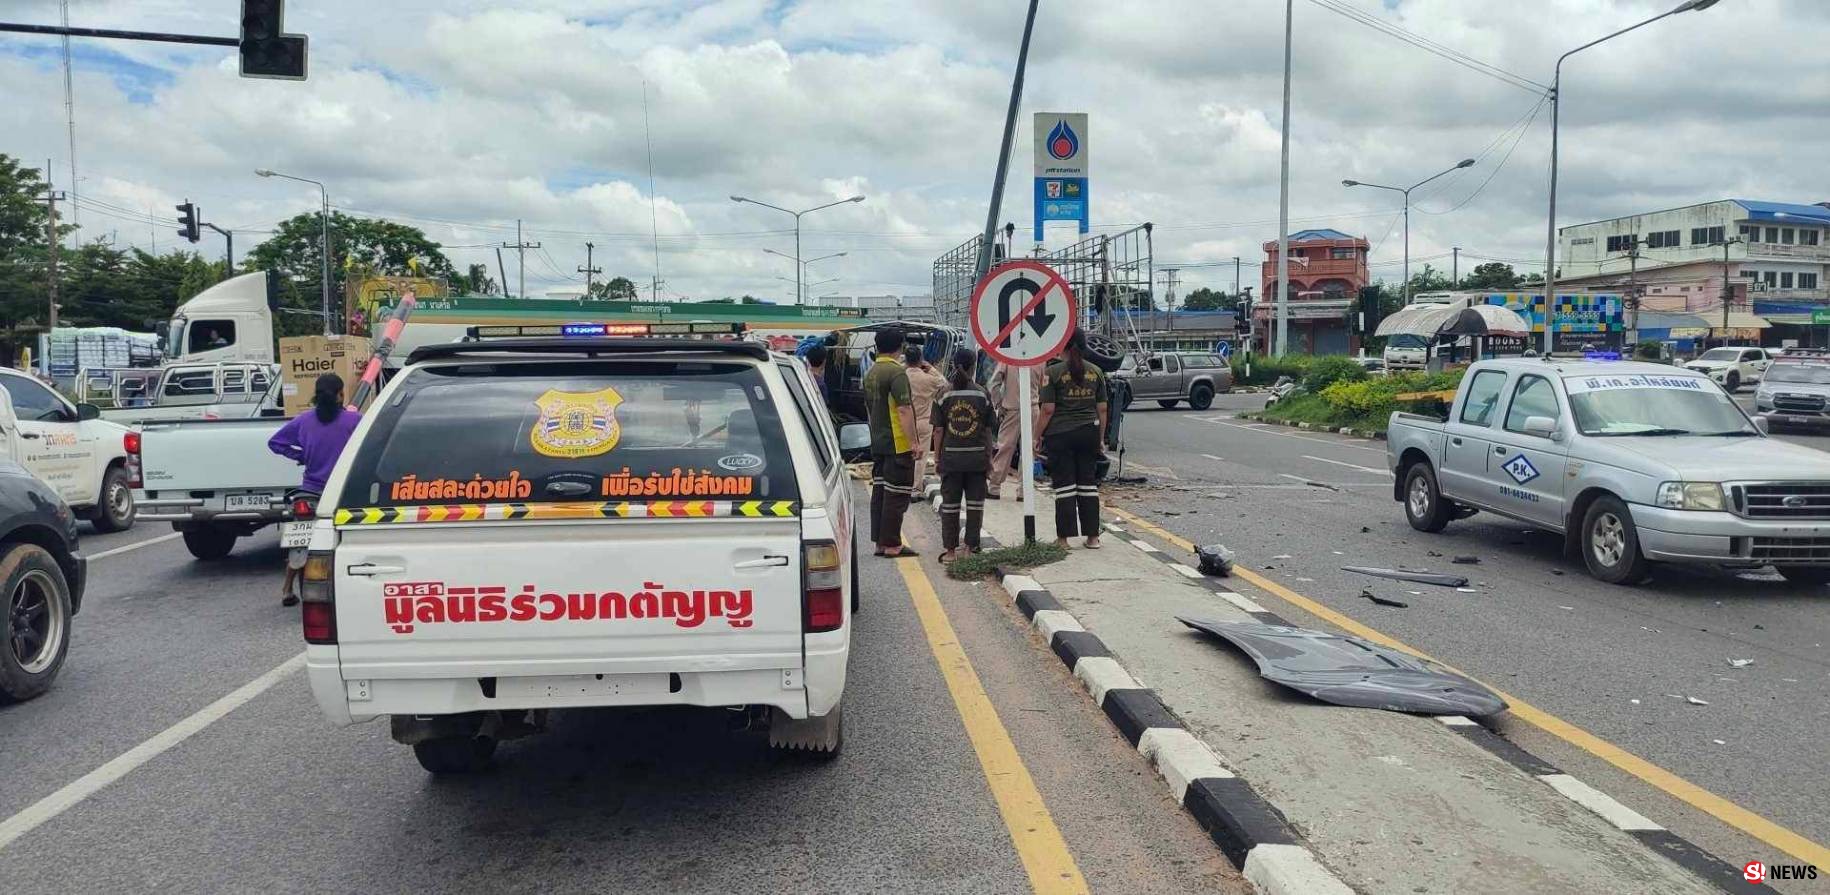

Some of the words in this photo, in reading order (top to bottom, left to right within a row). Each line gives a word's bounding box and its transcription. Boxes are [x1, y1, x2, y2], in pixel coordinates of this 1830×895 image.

[292, 356, 337, 372] Haier
[1513, 462, 1530, 477] P.K.
[384, 583, 445, 597] อาสา
[384, 582, 754, 634] มูลนิธิร่วมกตัญญู
